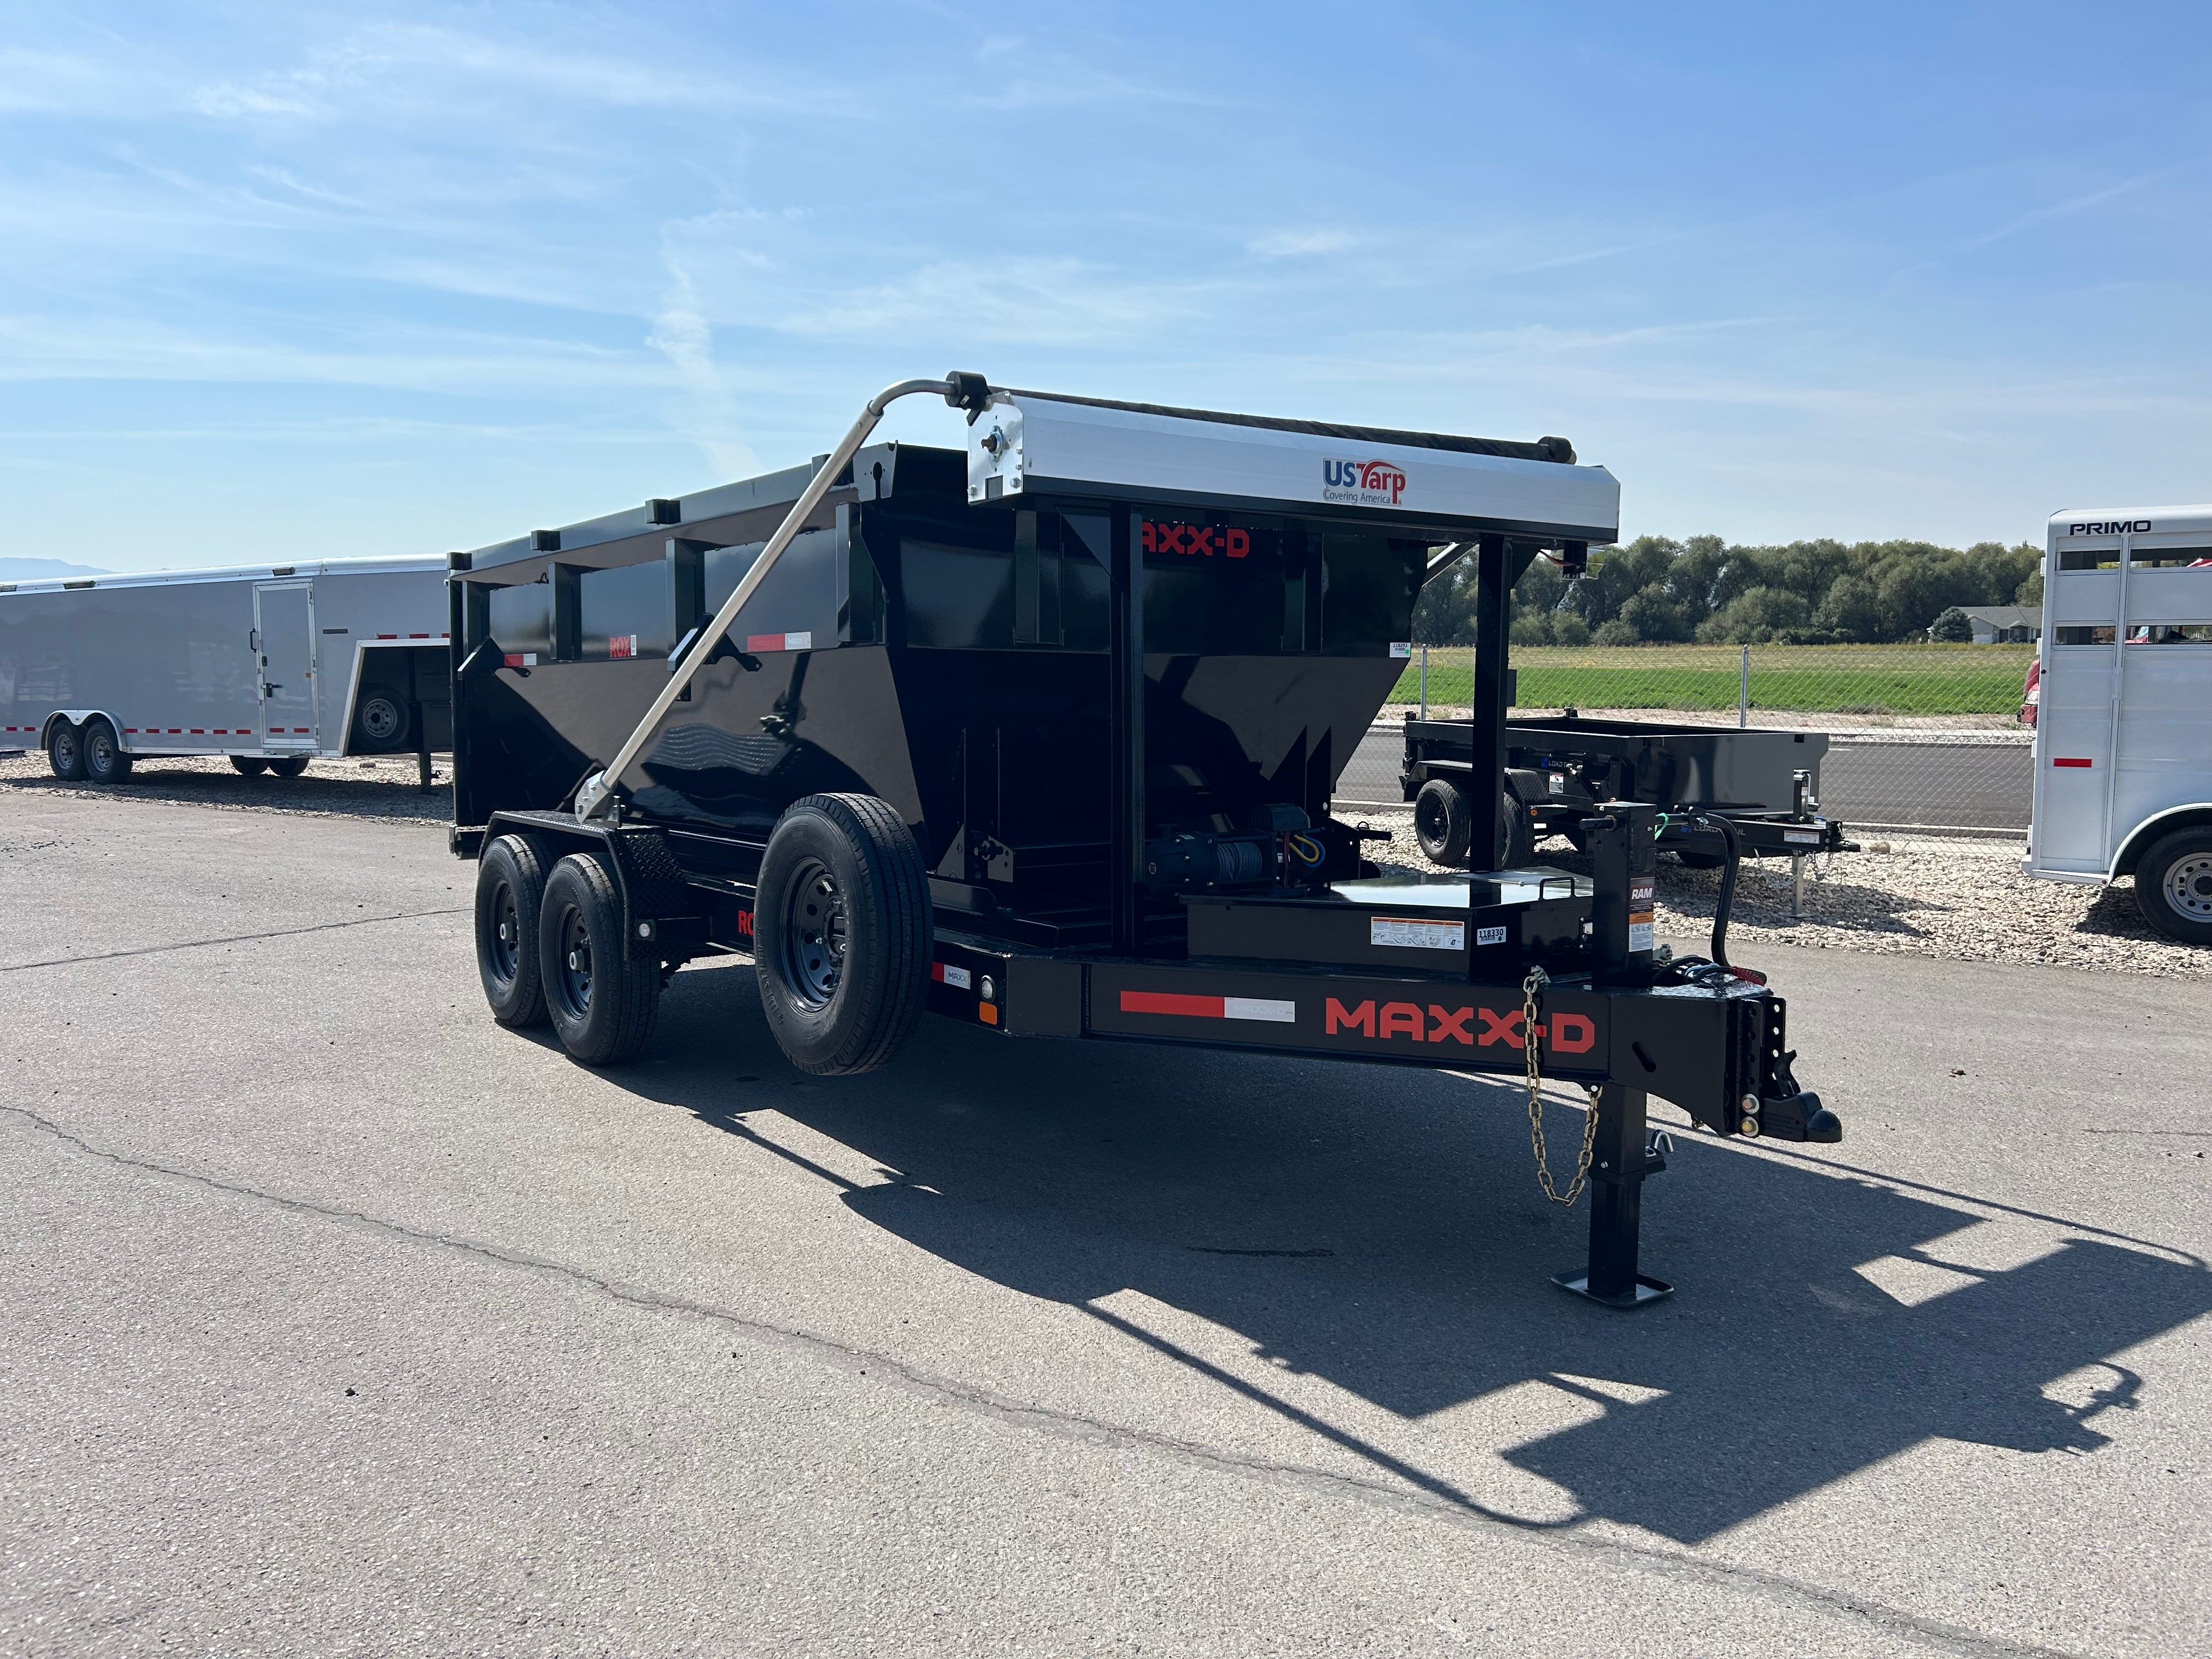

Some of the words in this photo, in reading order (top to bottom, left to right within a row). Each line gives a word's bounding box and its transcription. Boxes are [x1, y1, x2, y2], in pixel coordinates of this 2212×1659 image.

[1324, 489, 1358, 504] Covering
[1361, 492, 1390, 504] America
[2069, 520, 2151, 536] PRIMO
[1142, 522, 1250, 558] AXX-D
[610, 635, 630, 658] ROX
[1631, 888, 1653, 900] RAM
[1479, 928, 1504, 938] 118330
[1325, 997, 1595, 1053] MAXX-D
